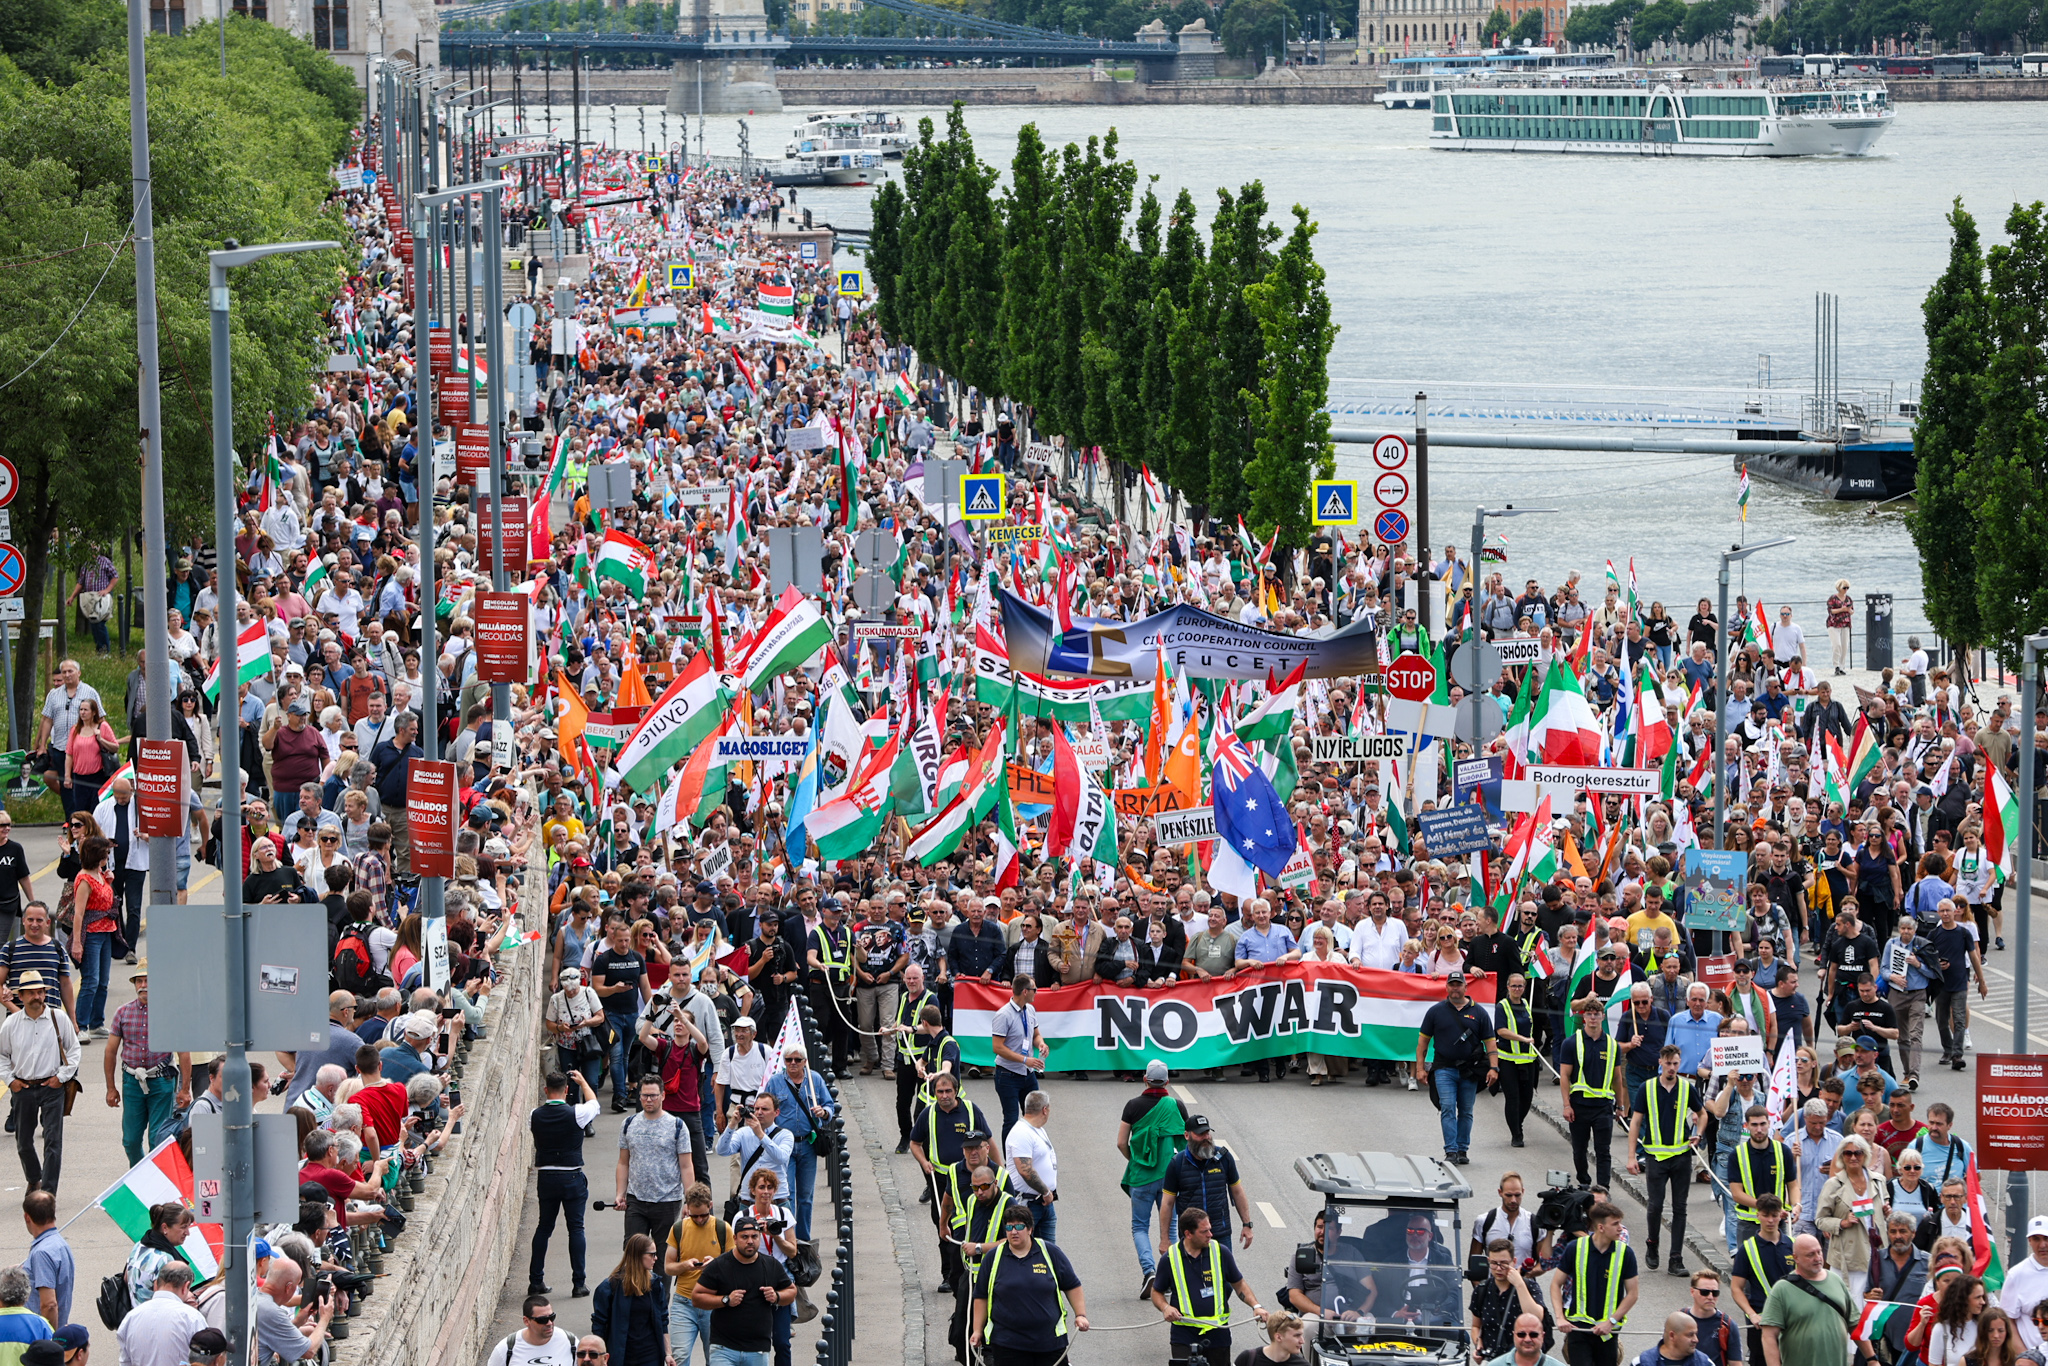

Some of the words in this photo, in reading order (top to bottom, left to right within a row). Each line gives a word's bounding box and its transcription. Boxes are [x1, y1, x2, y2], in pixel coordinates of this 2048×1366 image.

[1027, 445, 1052, 463] GYUGY
[1382, 445, 1399, 461] 40
[1850, 479, 1875, 488] U-10121
[988, 525, 1042, 541] KEMECSE
[477, 622, 524, 632] MILLIÁRDOS
[856, 627, 920, 636] KISKUNMAJSA
[1176, 615, 1240, 633] EUROPEAN
[478, 631, 523, 642] MEGOLDÁS
[1177, 631, 1262, 649] COOPERATION
[1263, 641, 1318, 652] COUNCIL
[1389, 667, 1434, 689] STOP
[718, 737, 808, 756] MAGOSLIGET
[1314, 736, 1404, 761] NYÍRLUGOS
[1459, 761, 1487, 772] VÁLASZD
[1533, 770, 1651, 790] Bodrogkeresztúr
[1426, 832, 1444, 845] Adj
[704, 861, 715, 878] NO
[712, 850, 730, 873] WAR
[1096, 997, 1199, 1050] NO
[1215, 977, 1359, 1042] WAR
[1724, 1052, 1749, 1060] GENDER
[1725, 1058, 1761, 1067] MIGRATION
